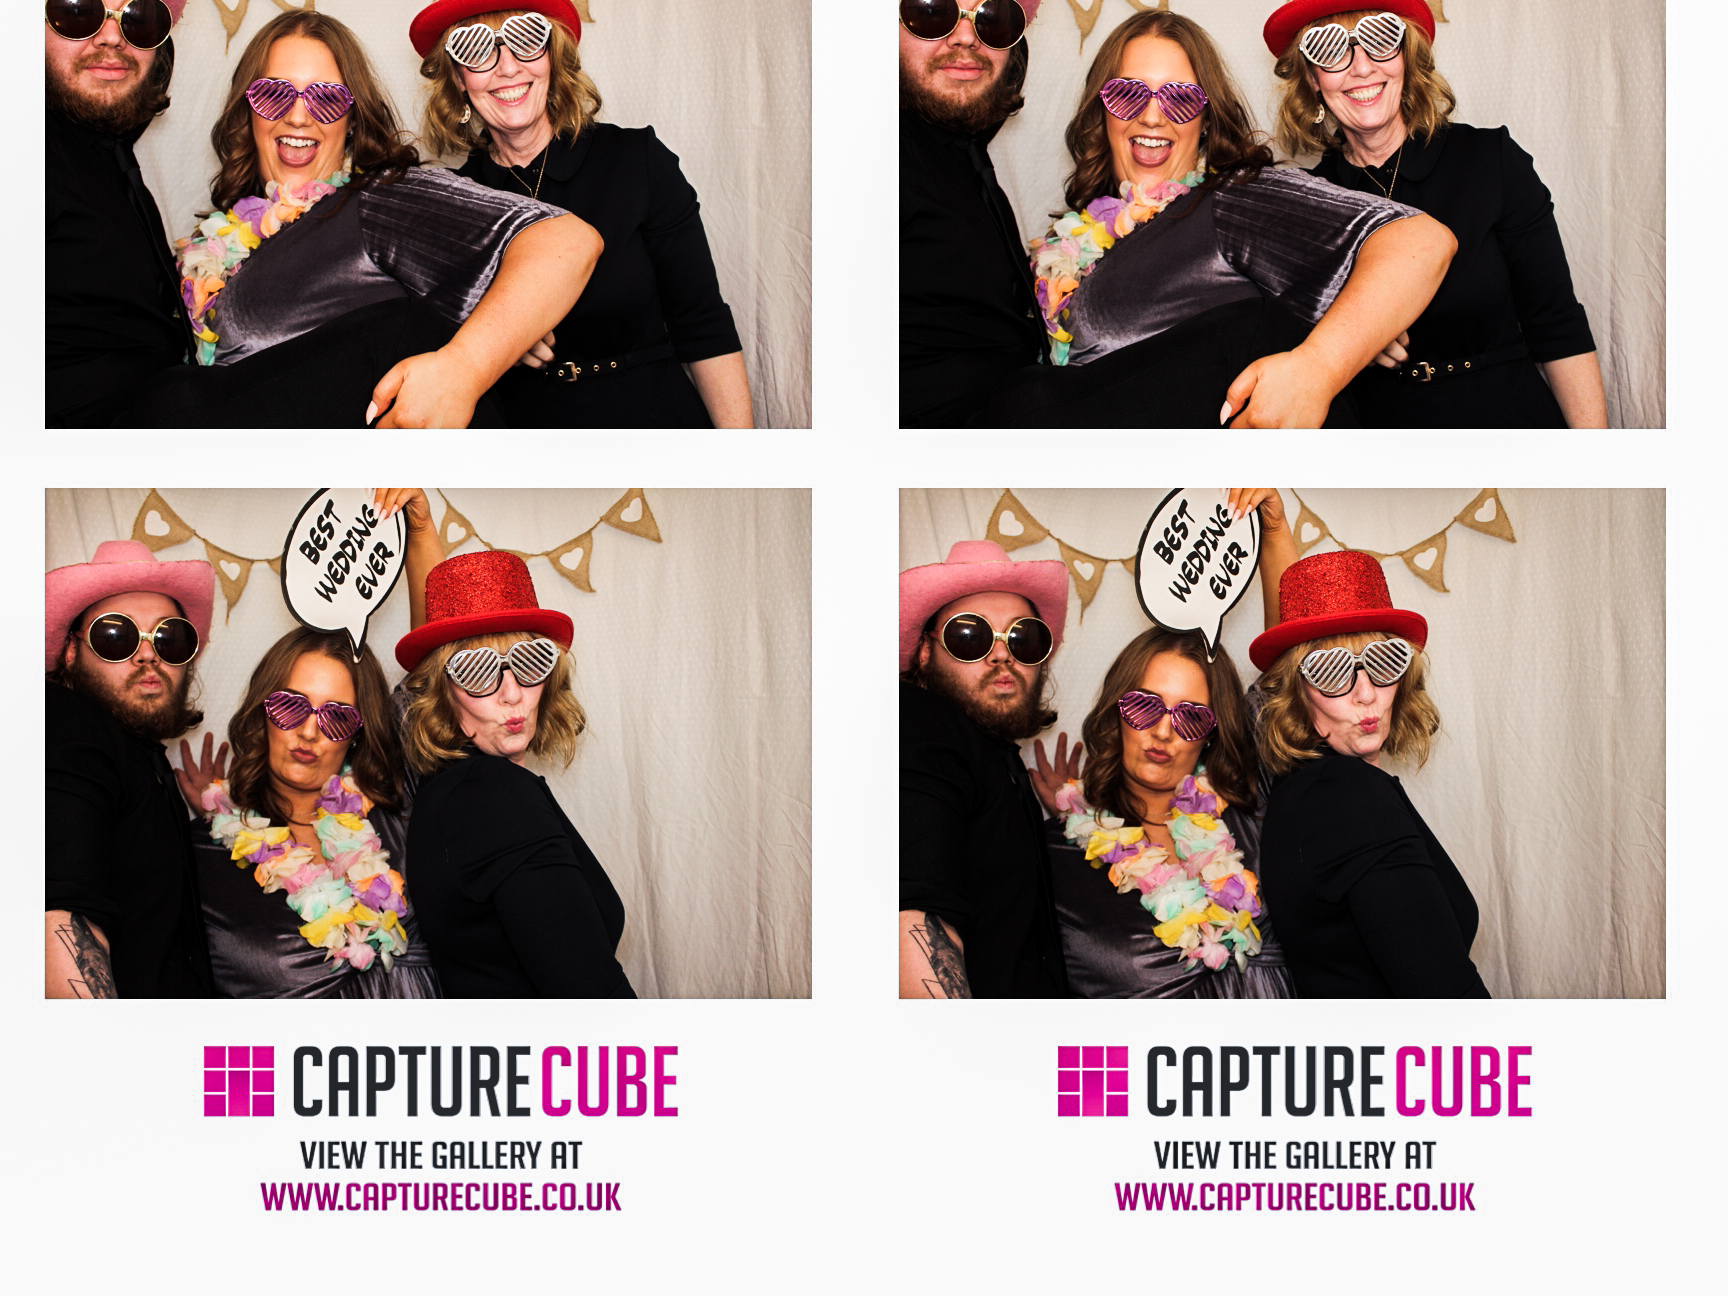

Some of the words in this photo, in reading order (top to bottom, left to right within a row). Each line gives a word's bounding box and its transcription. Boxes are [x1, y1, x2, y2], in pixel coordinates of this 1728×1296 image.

[299, 498, 342, 566] BEST
[314, 503, 379, 603] WEDDING
[1153, 498, 1196, 566] BEST
[1168, 503, 1233, 603] WEDDING
[355, 541, 395, 600] EVER
[1209, 541, 1249, 600] EVER
